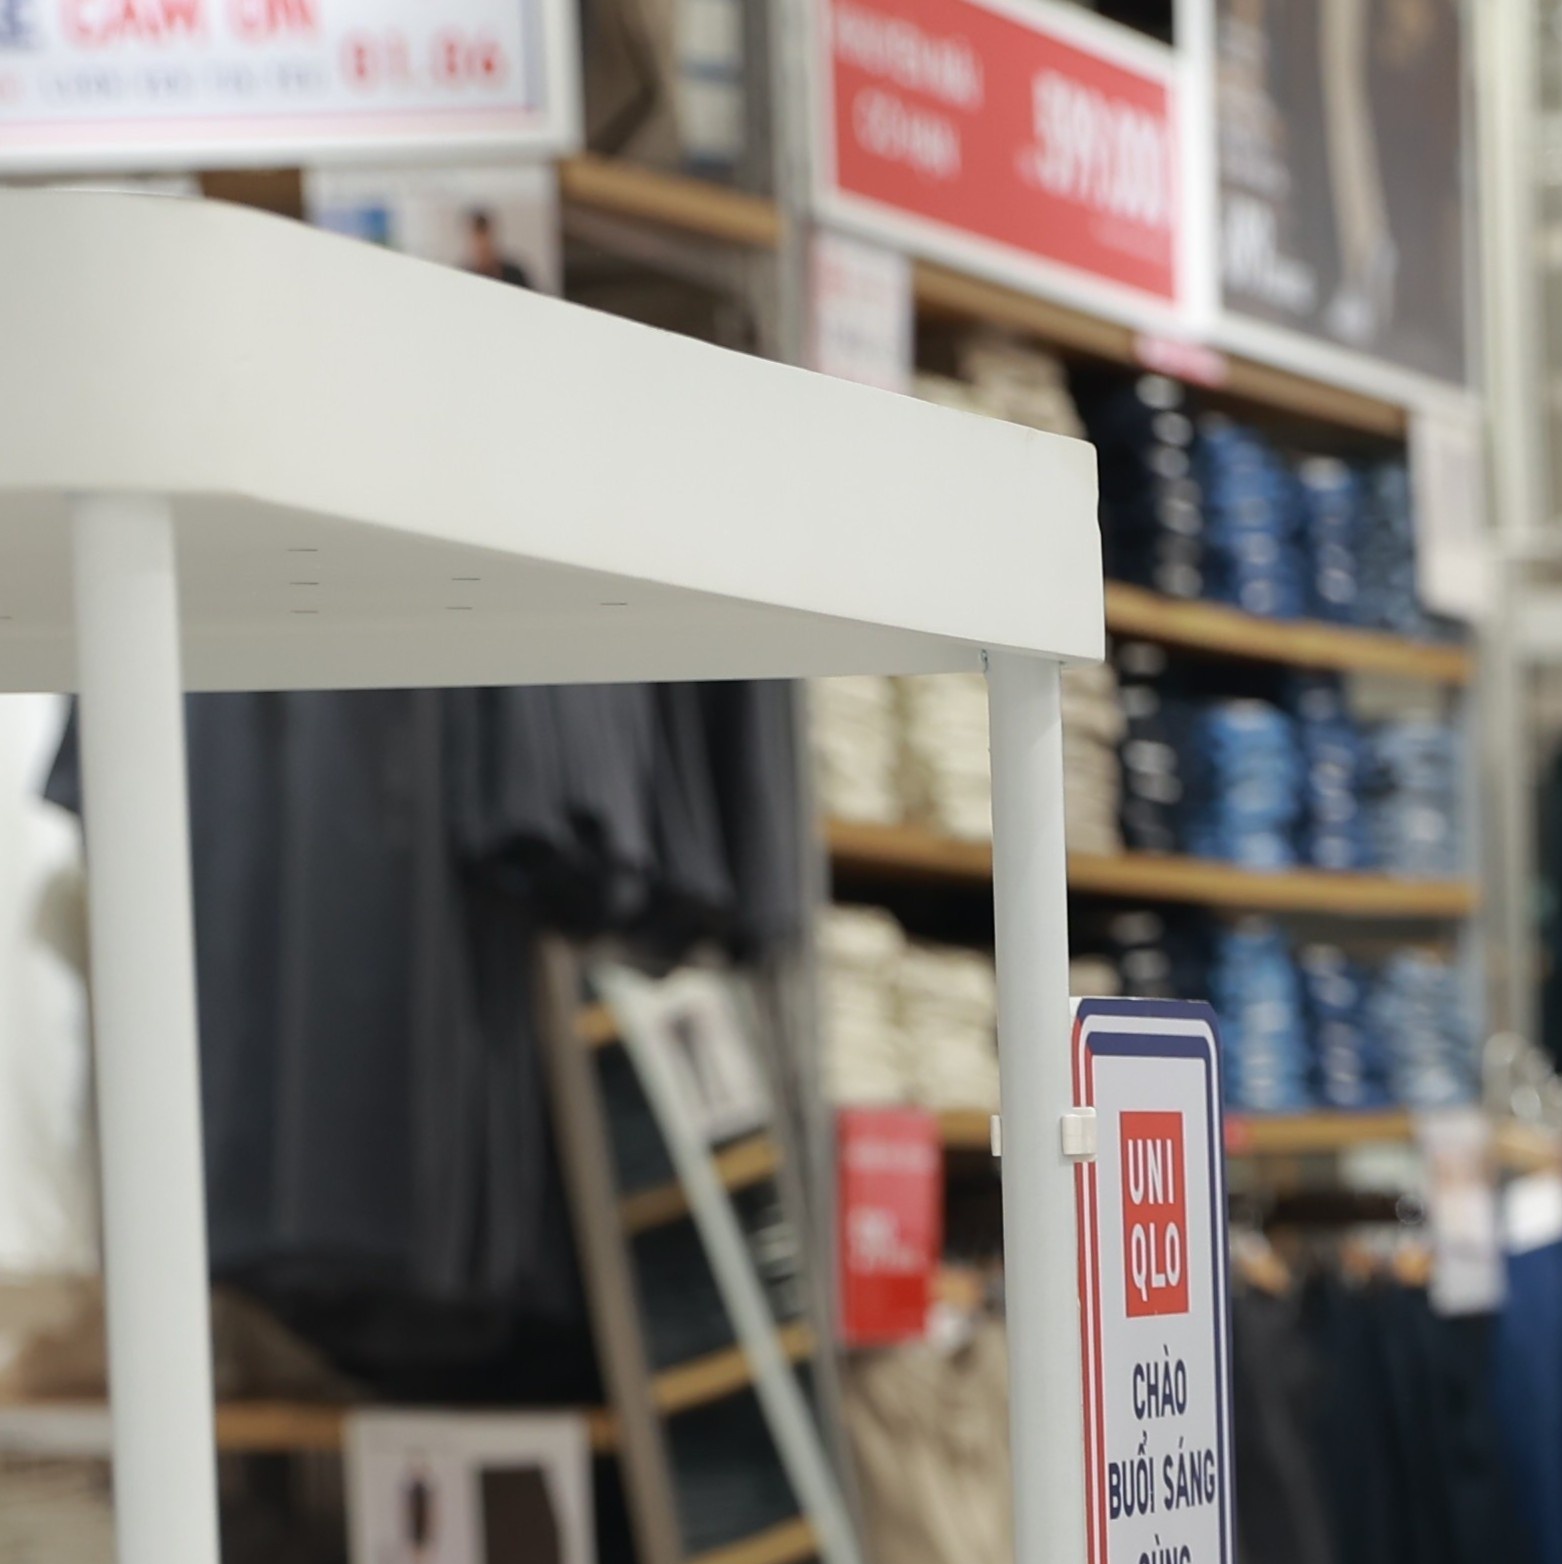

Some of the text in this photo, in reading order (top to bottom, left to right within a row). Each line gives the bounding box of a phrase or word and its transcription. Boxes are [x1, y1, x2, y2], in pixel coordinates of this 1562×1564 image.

[1126, 1137, 1175, 1206] UNI
[1130, 1221, 1181, 1303] QLO
[1132, 1345, 1188, 1420] CHÀO
[1109, 1432, 1216, 1520] BUỔI SÁNG
